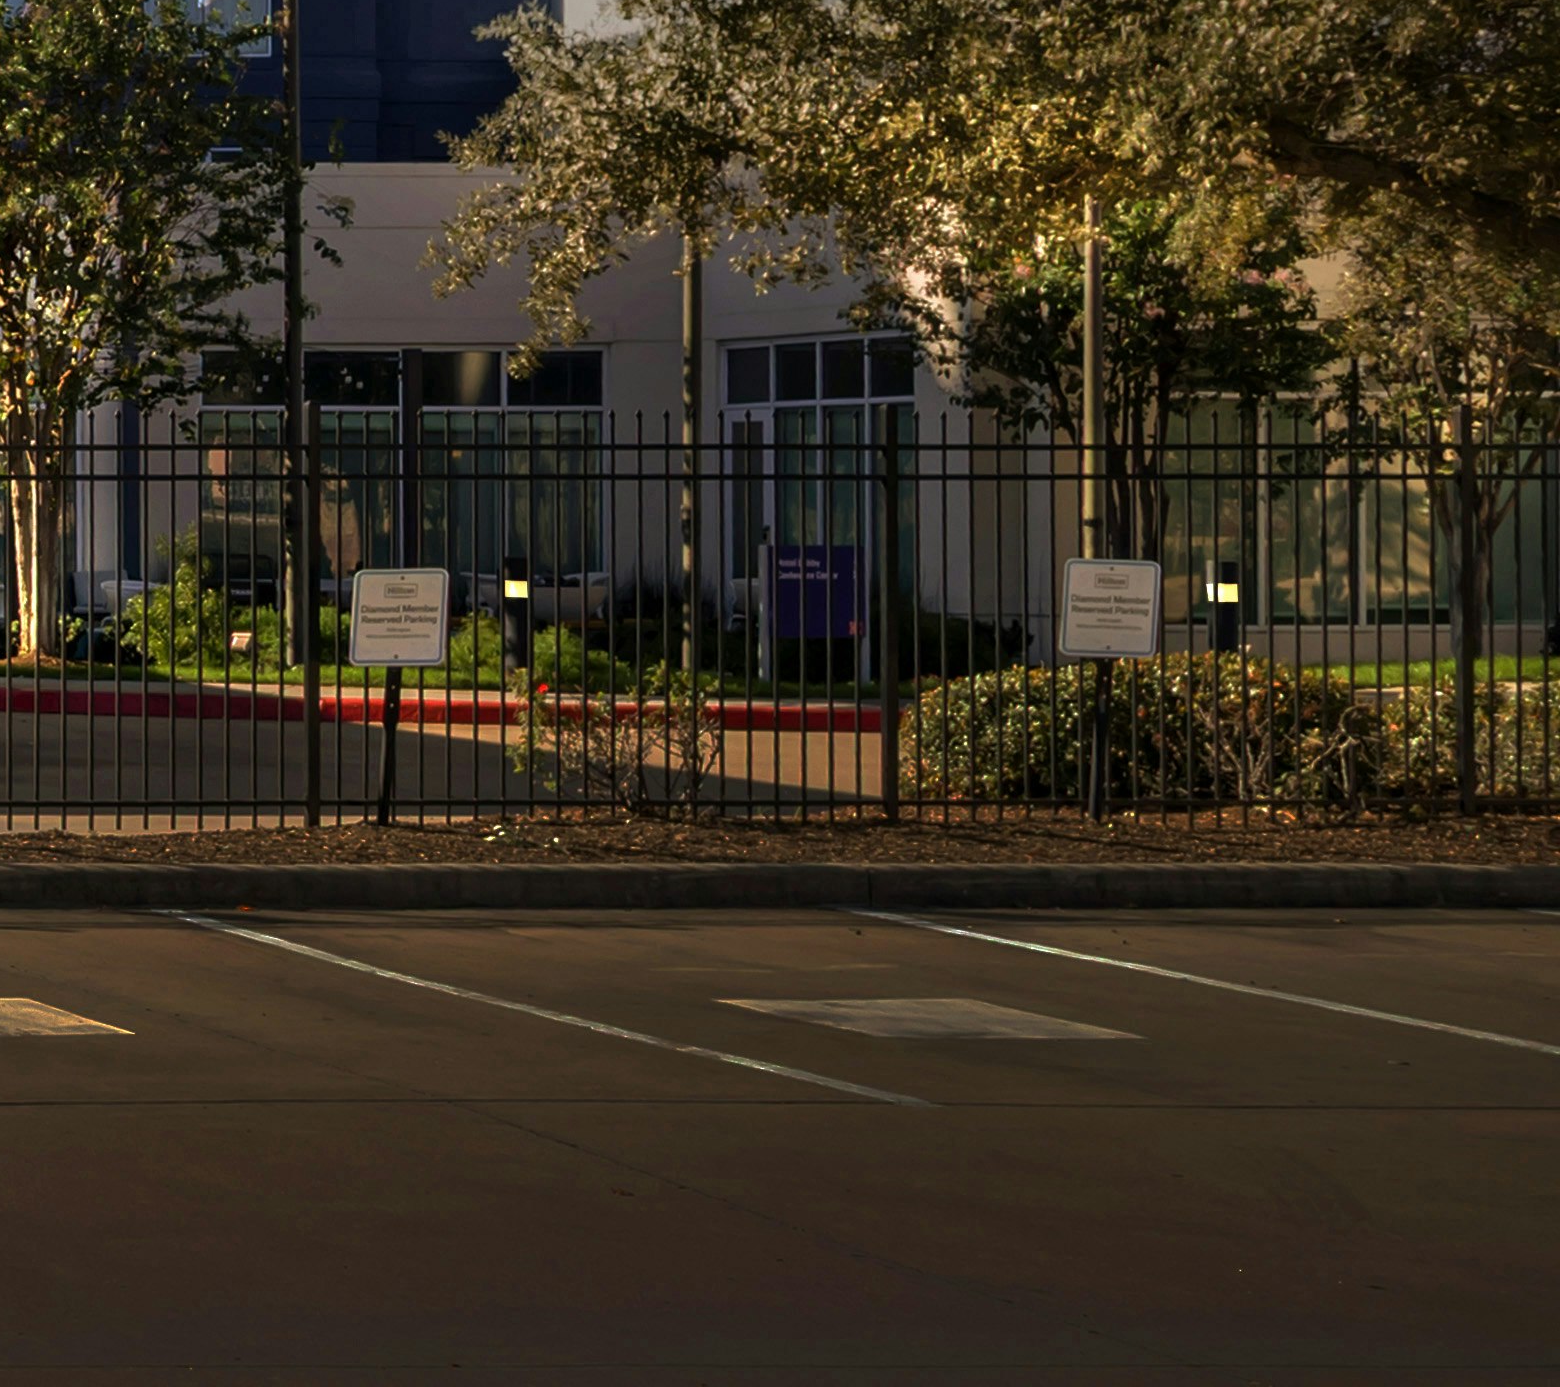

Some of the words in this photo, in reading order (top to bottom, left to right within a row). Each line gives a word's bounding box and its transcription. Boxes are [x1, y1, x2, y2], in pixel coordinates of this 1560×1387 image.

[361, 605, 400, 613] Diamond
[402, 605, 439, 613] Member
[404, 616, 437, 624] Parking
